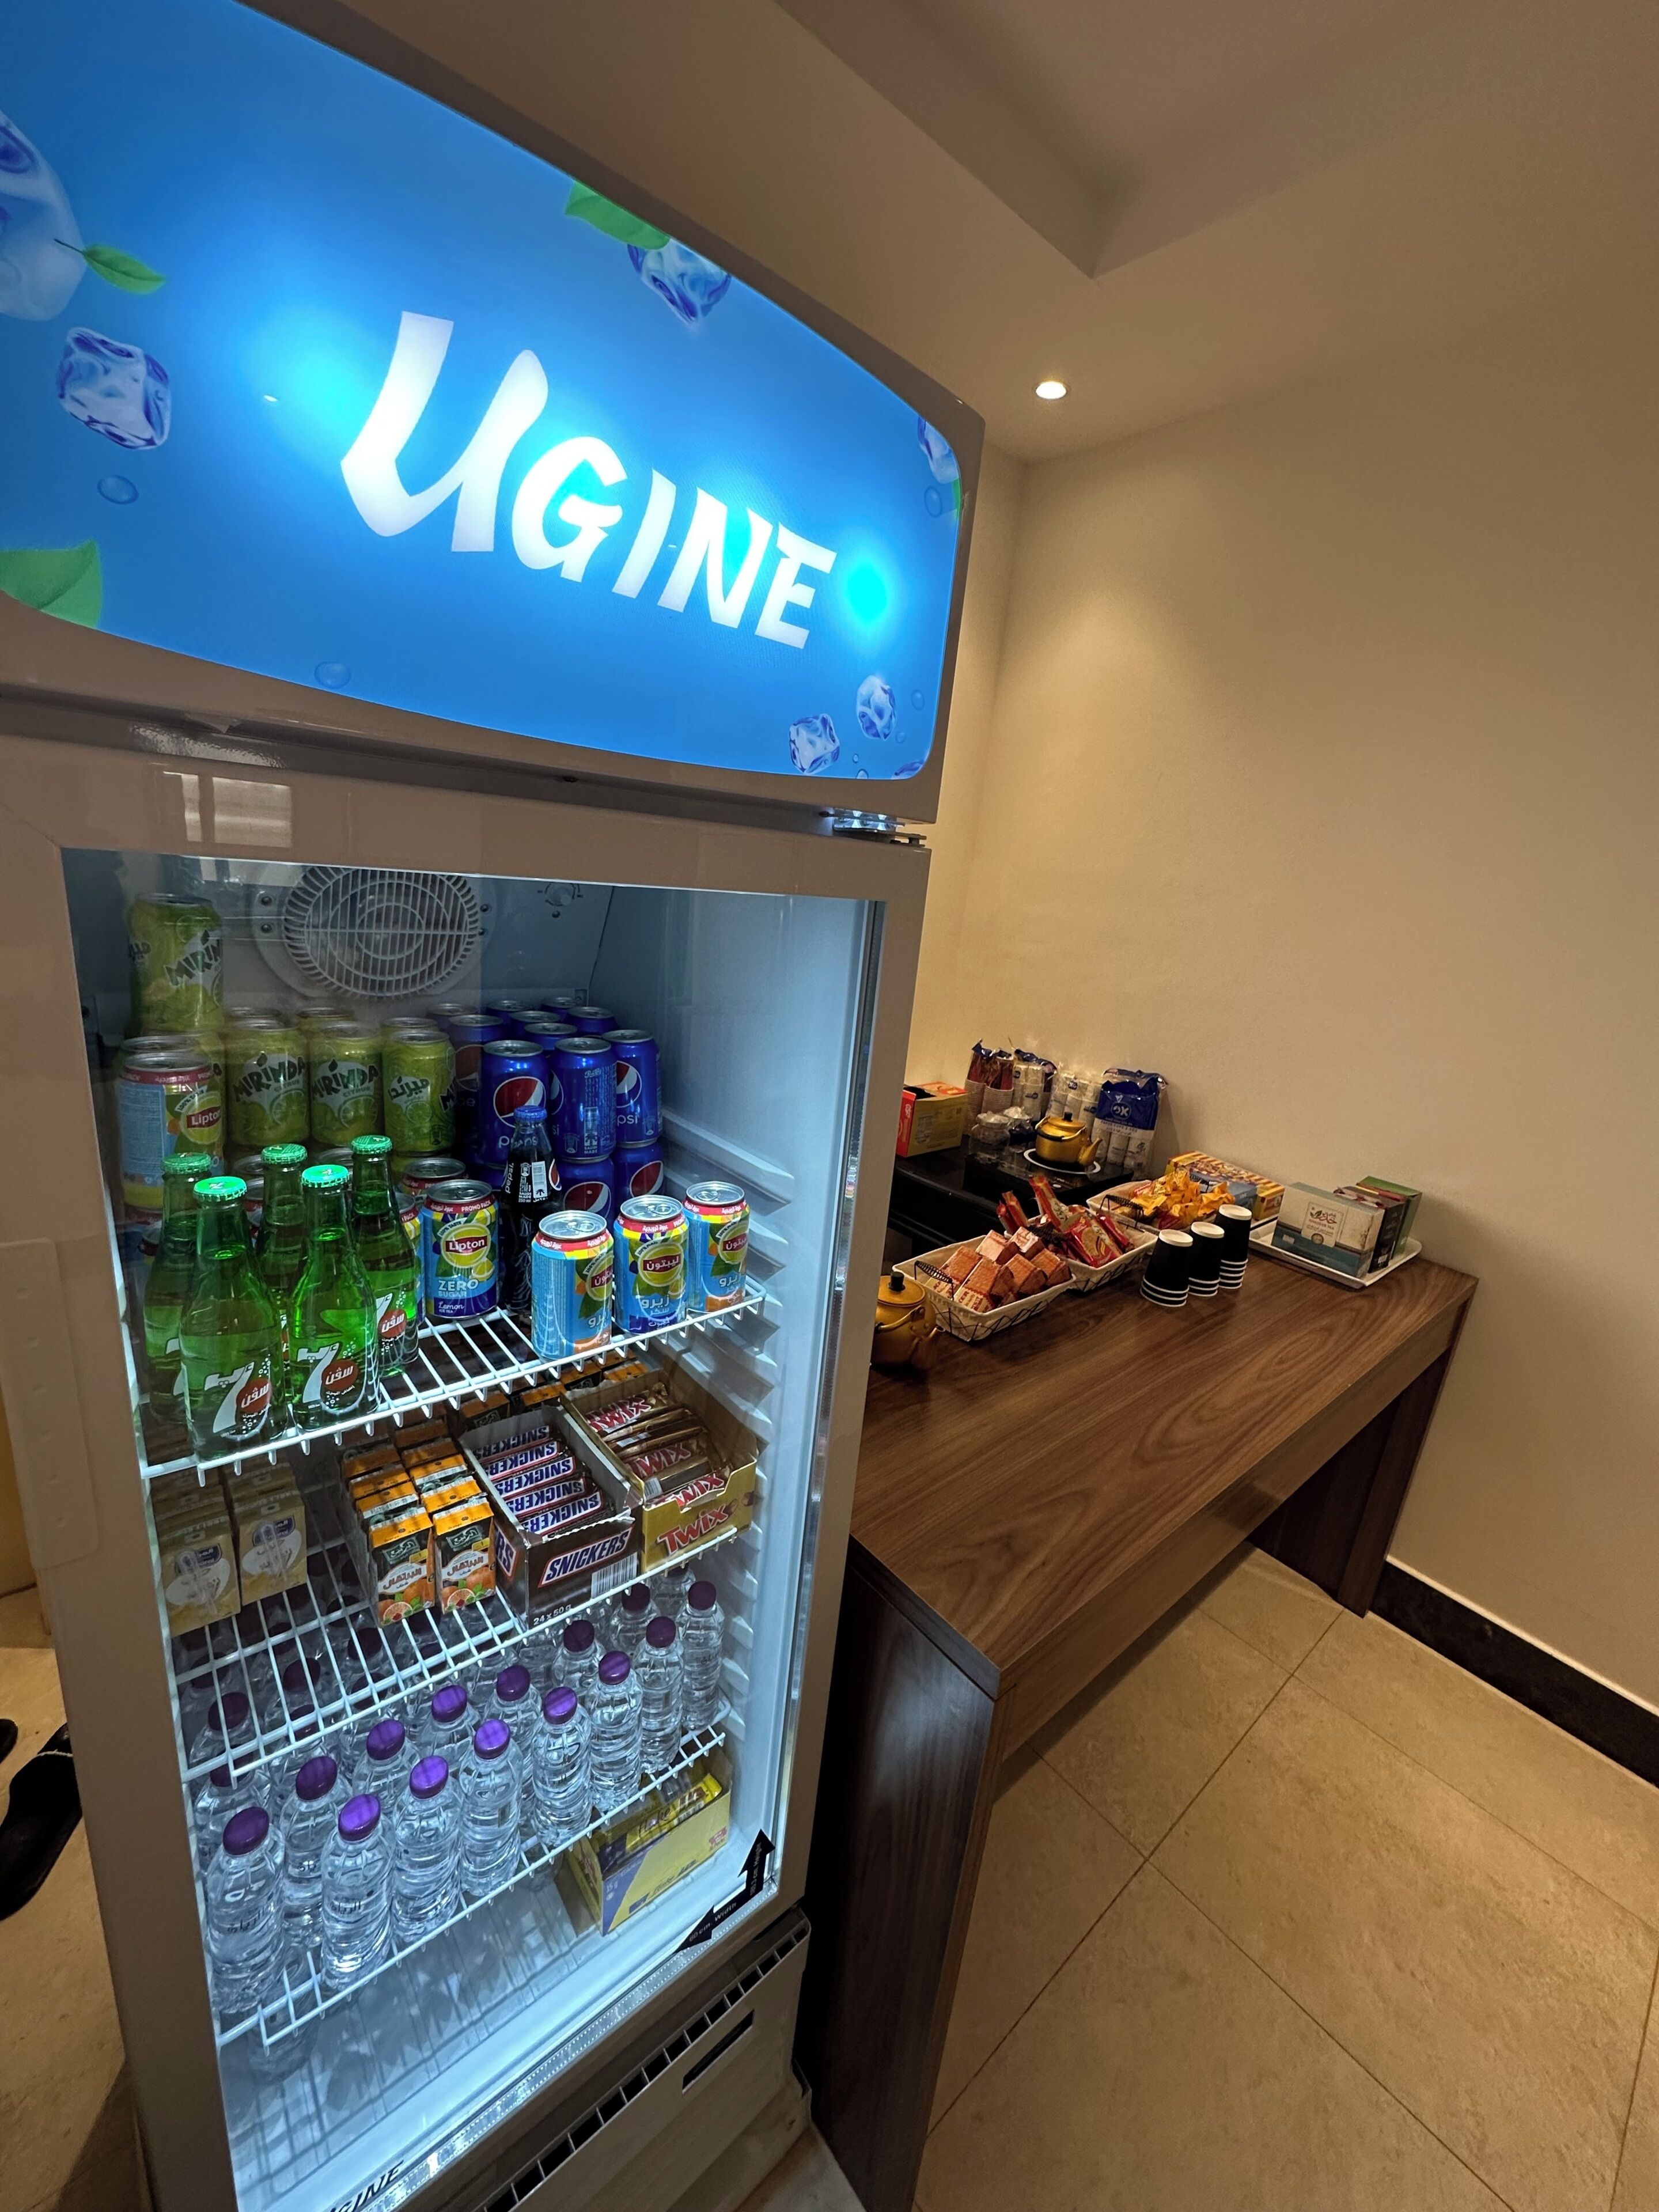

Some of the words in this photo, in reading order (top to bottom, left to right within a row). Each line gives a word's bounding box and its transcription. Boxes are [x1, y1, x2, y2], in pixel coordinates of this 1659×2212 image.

[341, 311, 836, 649] UGINE
[165, 930, 222, 986] MIRIN
[232, 1053, 306, 1102] MIRINDA
[617, 1112, 638, 1127] psi
[461, 1204, 480, 1212] PROMO
[449, 1239, 485, 1252] Lipton
[646, 1255, 679, 1271] ليبتون
[438, 1279, 479, 1291] ZERO
[438, 1301, 465, 1309] Lemon
[641, 1294, 670, 1309] زيرو
[546, 1530, 630, 1582] SNICKERS
[446, 1556, 484, 1577] البرتقال
[382, 1567, 422, 1590] البرتقال
[533, 1614, 546, 1626] 24
[553, 1605, 565, 1615] 50
[714, 1902, 737, 1922] Width
[329, 2160, 404, 2212] GINE
